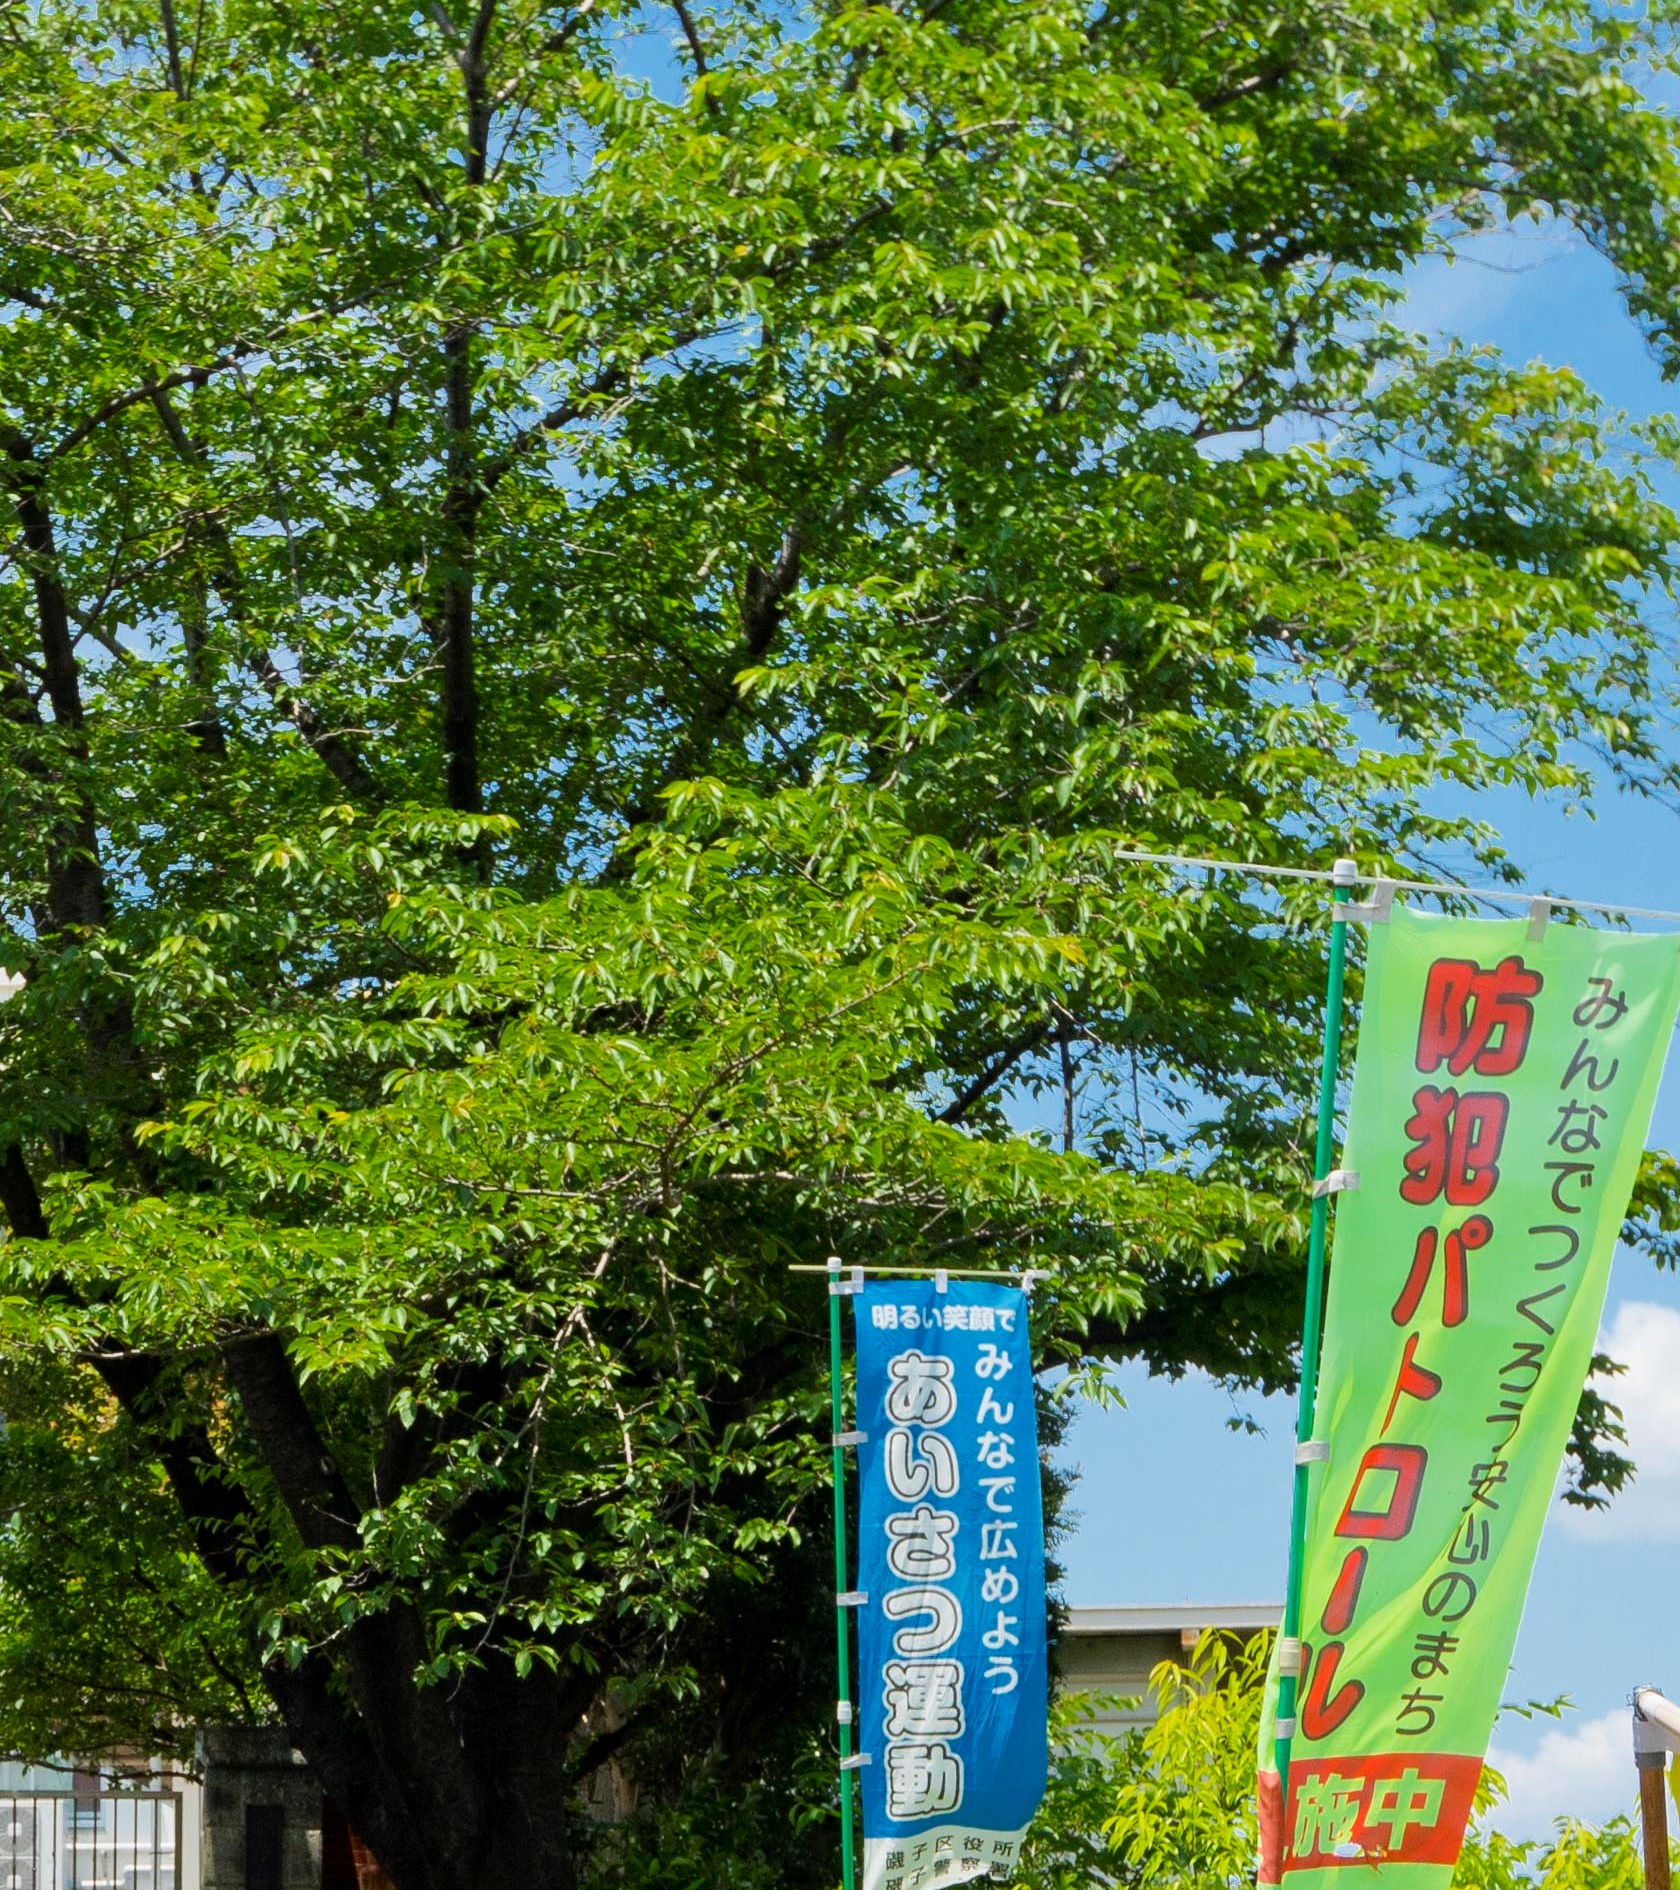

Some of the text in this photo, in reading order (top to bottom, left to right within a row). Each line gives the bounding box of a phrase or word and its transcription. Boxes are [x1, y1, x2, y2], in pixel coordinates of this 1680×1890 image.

[871, 1304, 1017, 1333] 明るい笑顔で
[1298, 954, 1543, 1741] 防犯パトロール
[1396, 976, 1628, 1735] みんなでつくろう安心のまち
[883, 1349, 965, 1822] あいさつ運動
[974, 1342, 1020, 1696] みんなで広めよう
[885, 1834, 1014, 1870] 磯子区役所
[1283, 1767, 1447, 1862] 施中
